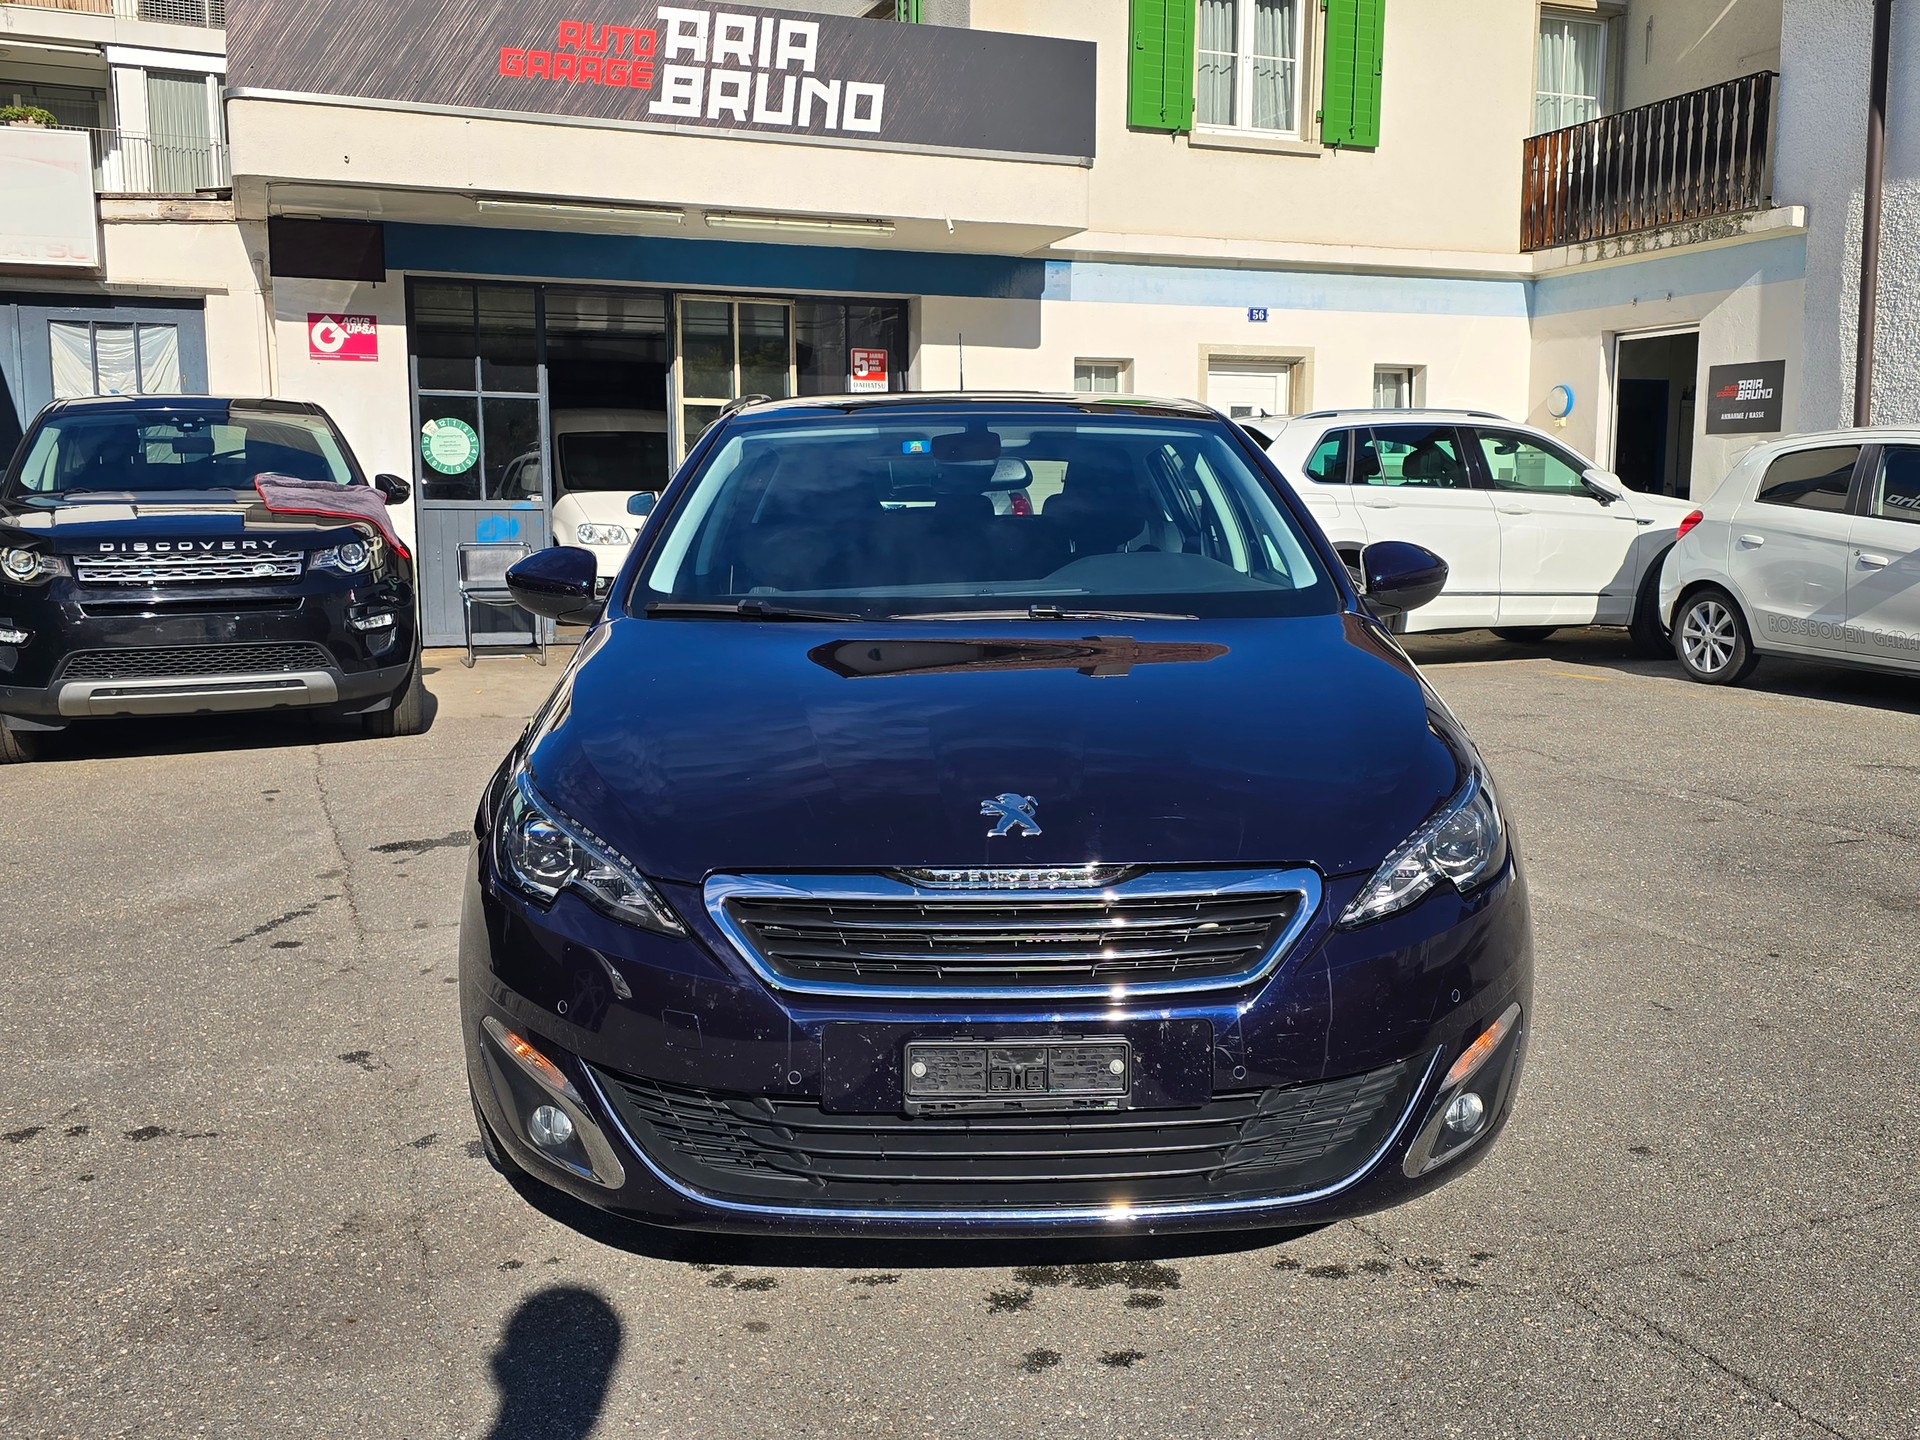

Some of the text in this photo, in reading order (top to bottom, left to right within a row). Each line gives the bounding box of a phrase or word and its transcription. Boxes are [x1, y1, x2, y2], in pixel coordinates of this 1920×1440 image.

[558, 20, 657, 57] AUTO
[657, 6, 820, 72] ARIA
[499, 47, 655, 89] GARAGE
[648, 64, 885, 133] BRUNO
[341, 316, 370, 326] AGVS
[1252, 309, 1265, 320] 56
[346, 325, 376, 335] UPSA
[854, 352, 869, 377] 5
[1738, 379, 1763, 390] ARIA
[1735, 388, 1773, 400] BRUNO
[99, 540, 277, 551] DISCOVERY
[1768, 614, 1920, 651] ROSSBODEN GARA
